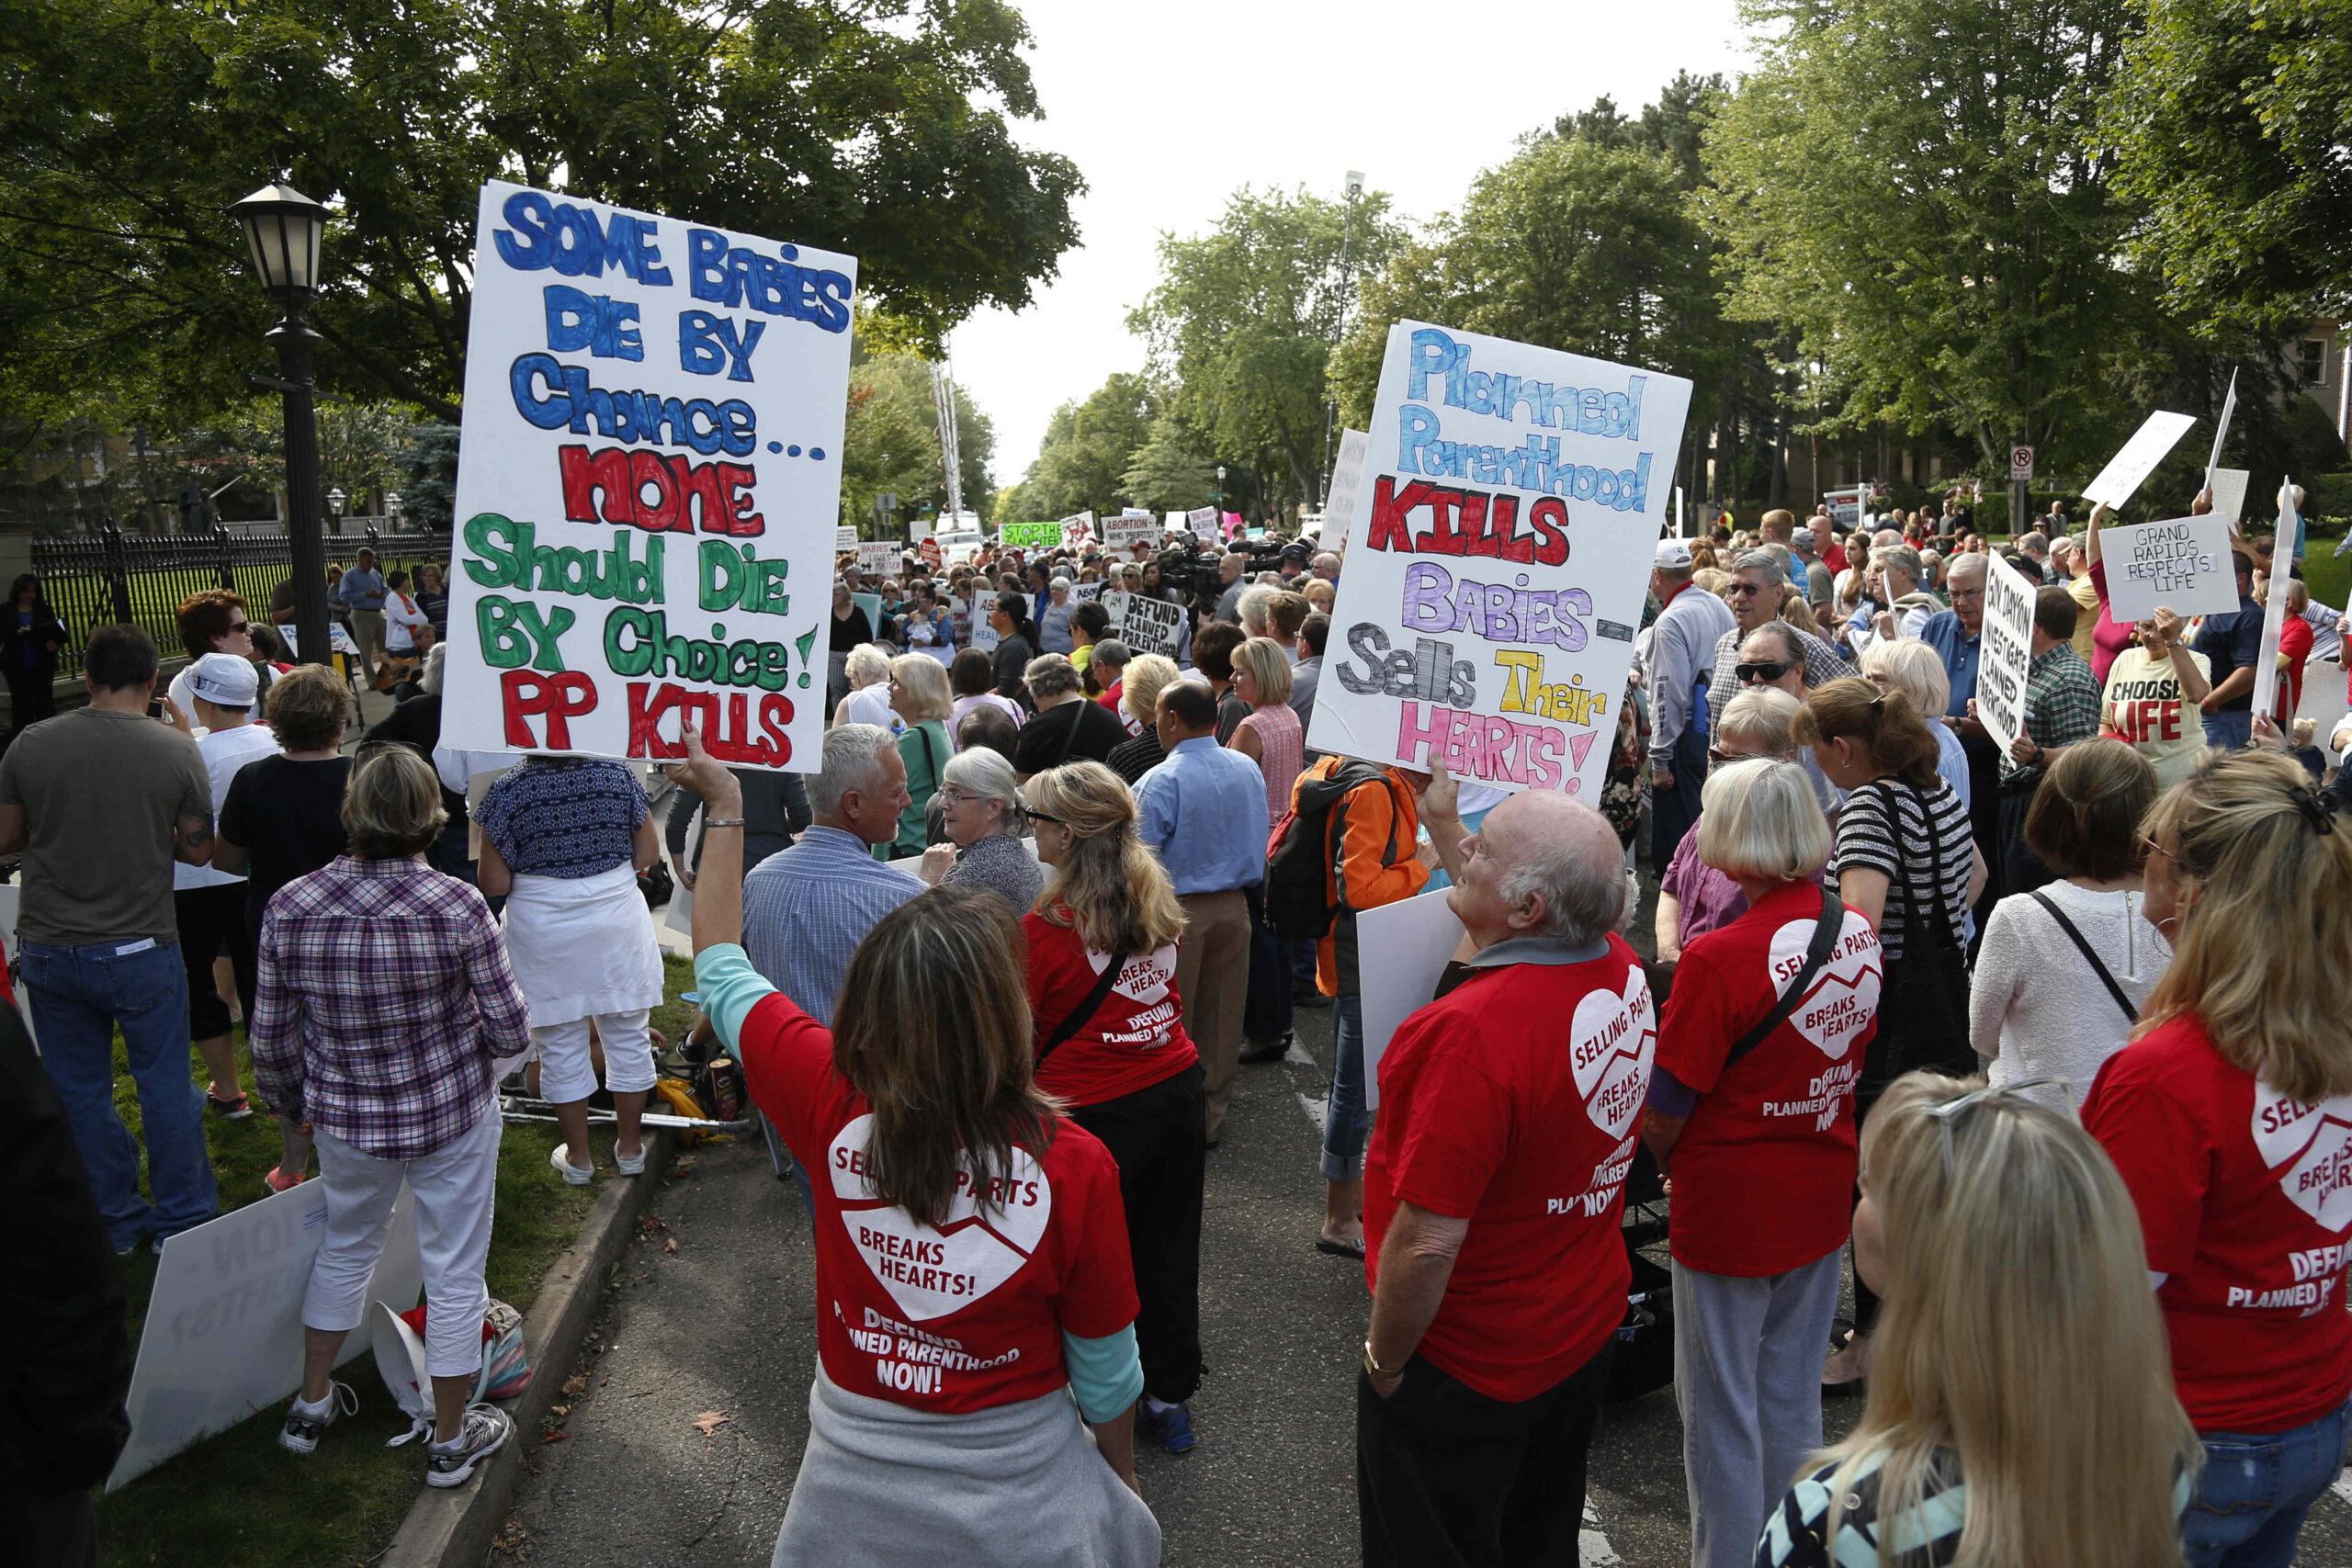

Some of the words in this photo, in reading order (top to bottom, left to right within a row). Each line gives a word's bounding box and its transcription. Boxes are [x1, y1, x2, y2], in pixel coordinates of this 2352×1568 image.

[493, 192, 673, 287] SOME
[544, 286, 644, 362] DIE
[678, 310, 766, 383] BY
[1408, 329, 1647, 441] Planned
[1397, 404, 1653, 513] Parenthood
[1005, 525, 1040, 537] STOP
[1042, 524, 1062, 535] THE
[1108, 532, 1124, 540] WHO
[1125, 530, 1154, 539] PROFITS?
[1367, 475, 1570, 567] KILLS
[2136, 525, 2189, 545] GRAND
[463, 513, 665, 605] Should
[869, 553, 890, 562] LIVES
[876, 561, 899, 570] MATTER
[2128, 556, 2211, 580] RESPECTS
[2134, 540, 2199, 562] RAPIDS
[2154, 574, 2195, 592] LIFE
[1128, 595, 1180, 626] DEFUND
[1988, 568, 2002, 613] GOV.
[2002, 584, 2031, 641] DAYTON
[478, 595, 575, 673] BY
[604, 607, 820, 692] Choice!
[1124, 614, 1169, 640] PLANNED
[1984, 617, 2027, 682] INVESTIGATE
[1336, 623, 1476, 708] Sells
[1495, 649, 1606, 727] Their
[1983, 648, 2017, 705] PLANNED
[2111, 680, 2180, 701] CHOOSE
[501, 671, 598, 750] PP
[627, 682, 795, 768] KILLS
[1979, 674, 2017, 739] PARENTHOOD
[2110, 701, 2181, 742] LIFE
[1396, 701, 1597, 795] HEARTS!
[1126, 1001, 1174, 1031] DEFUND
[1805, 995, 1856, 1030] BREAKS
[1102, 1029, 1152, 1043] PLANNED
[1575, 1011, 1628, 1070] SELLING
[1763, 1098, 1826, 1117] PLANNED
[860, 1225, 944, 1266] BREAKS
[879, 1257, 976, 1296] HEARTS!
[2226, 1281, 2317, 1308] PLANNED
[897, 1337, 1020, 1371] PARENTHOOD
[876, 1359, 942, 1394] NOW!
